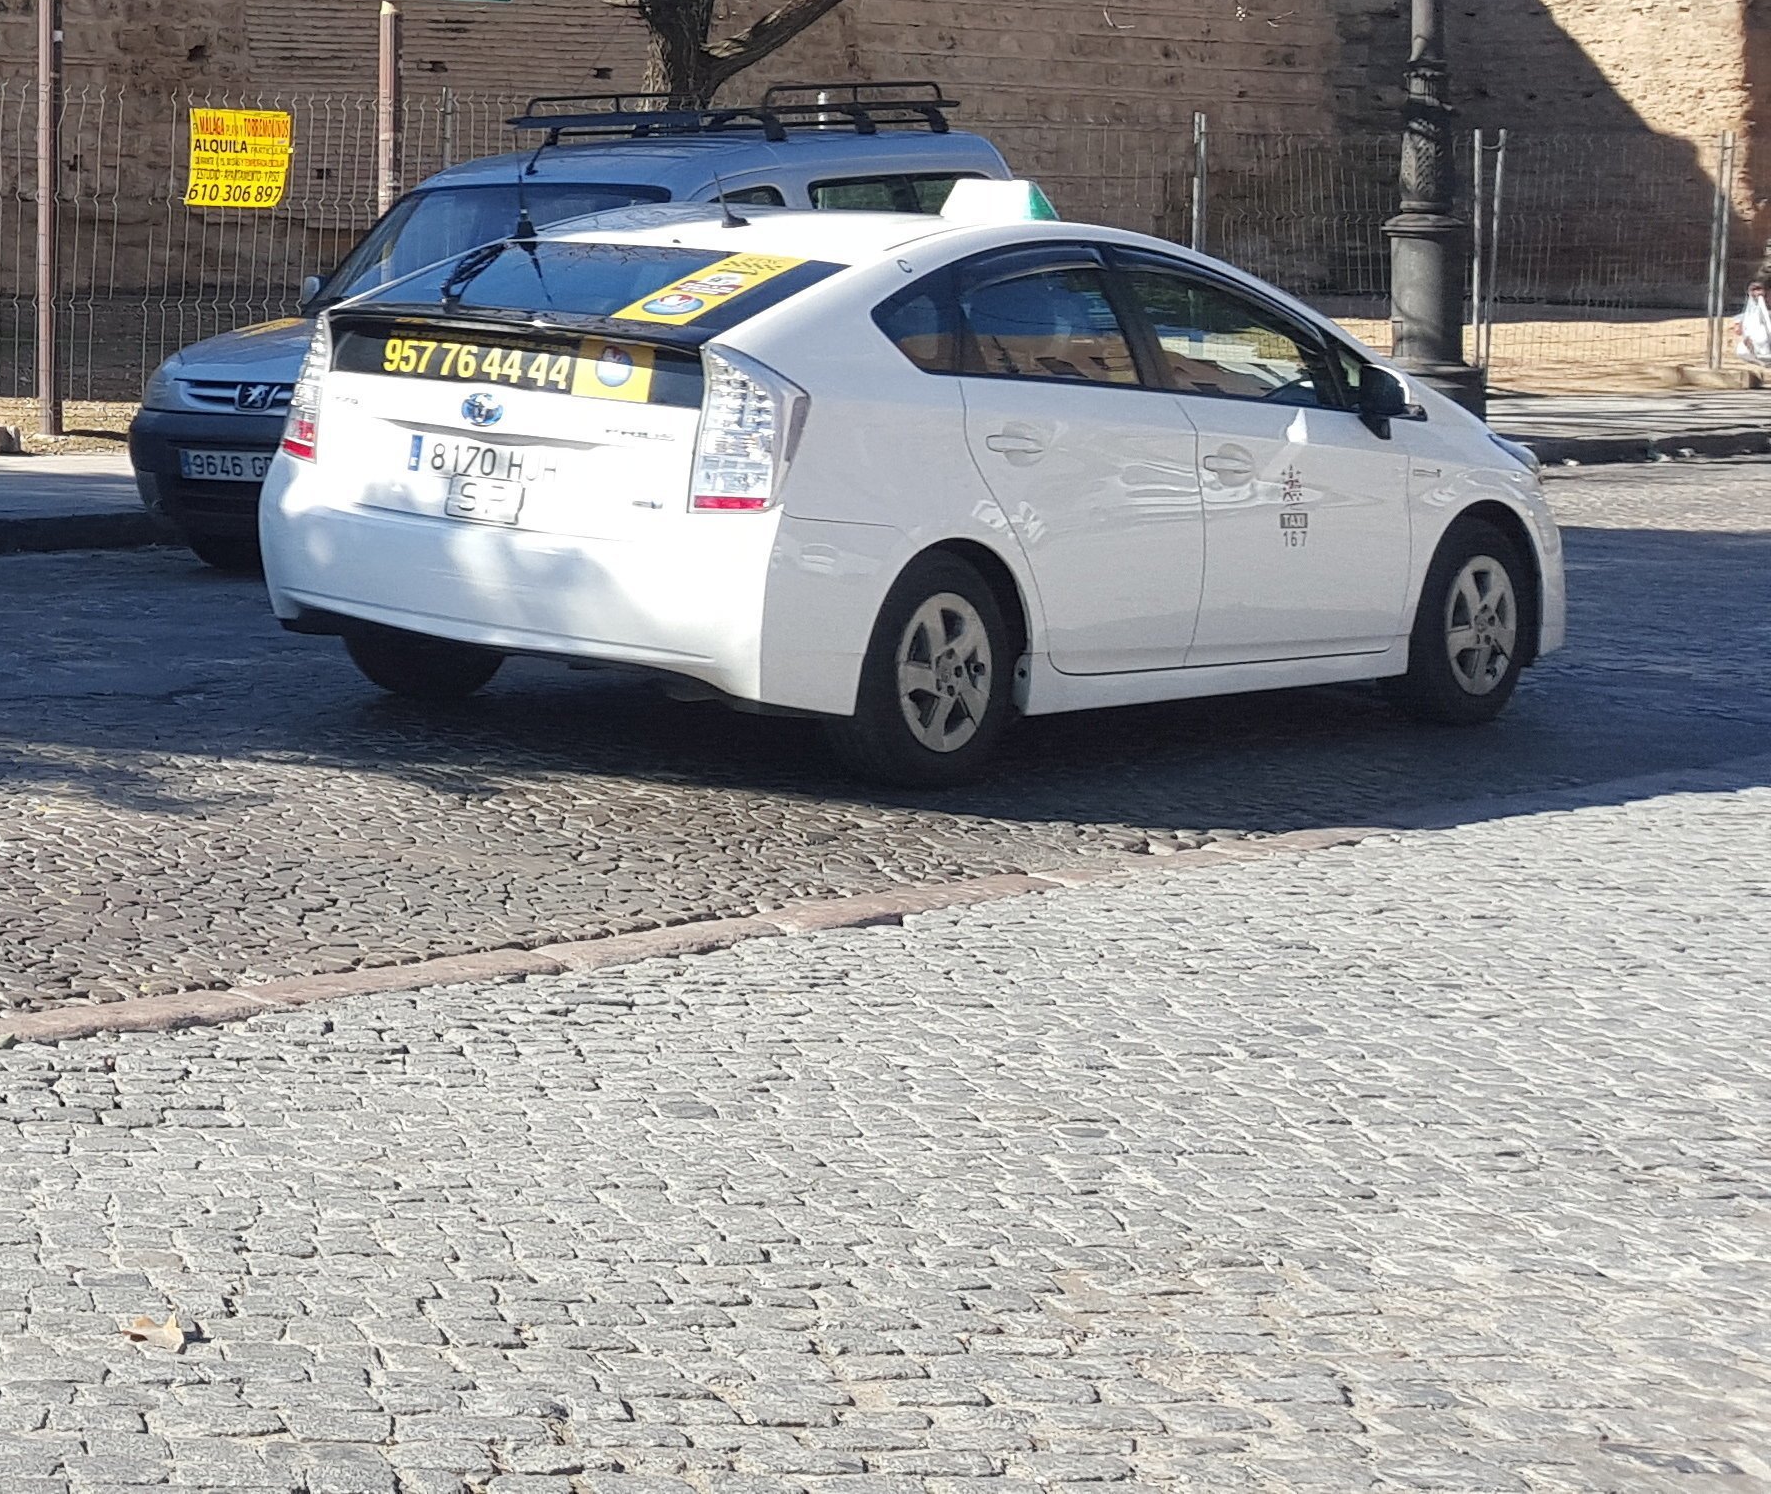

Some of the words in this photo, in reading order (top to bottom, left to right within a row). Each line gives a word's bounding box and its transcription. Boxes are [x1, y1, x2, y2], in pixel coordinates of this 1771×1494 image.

[194, 138, 248, 154] ALQUILA
[188, 183, 219, 201] 610
[222, 185, 251, 202] 306
[254, 186, 281, 203] 897
[383, 338, 438, 373] 957
[440, 342, 479, 378] 76
[482, 348, 523, 384] 44
[528, 353, 572, 390] 44
[192, 454, 244, 477] 9646
[430, 443, 497, 476] 8170
[1283, 514, 1306, 528] TAXI
[1283, 531, 1307, 547] 167
